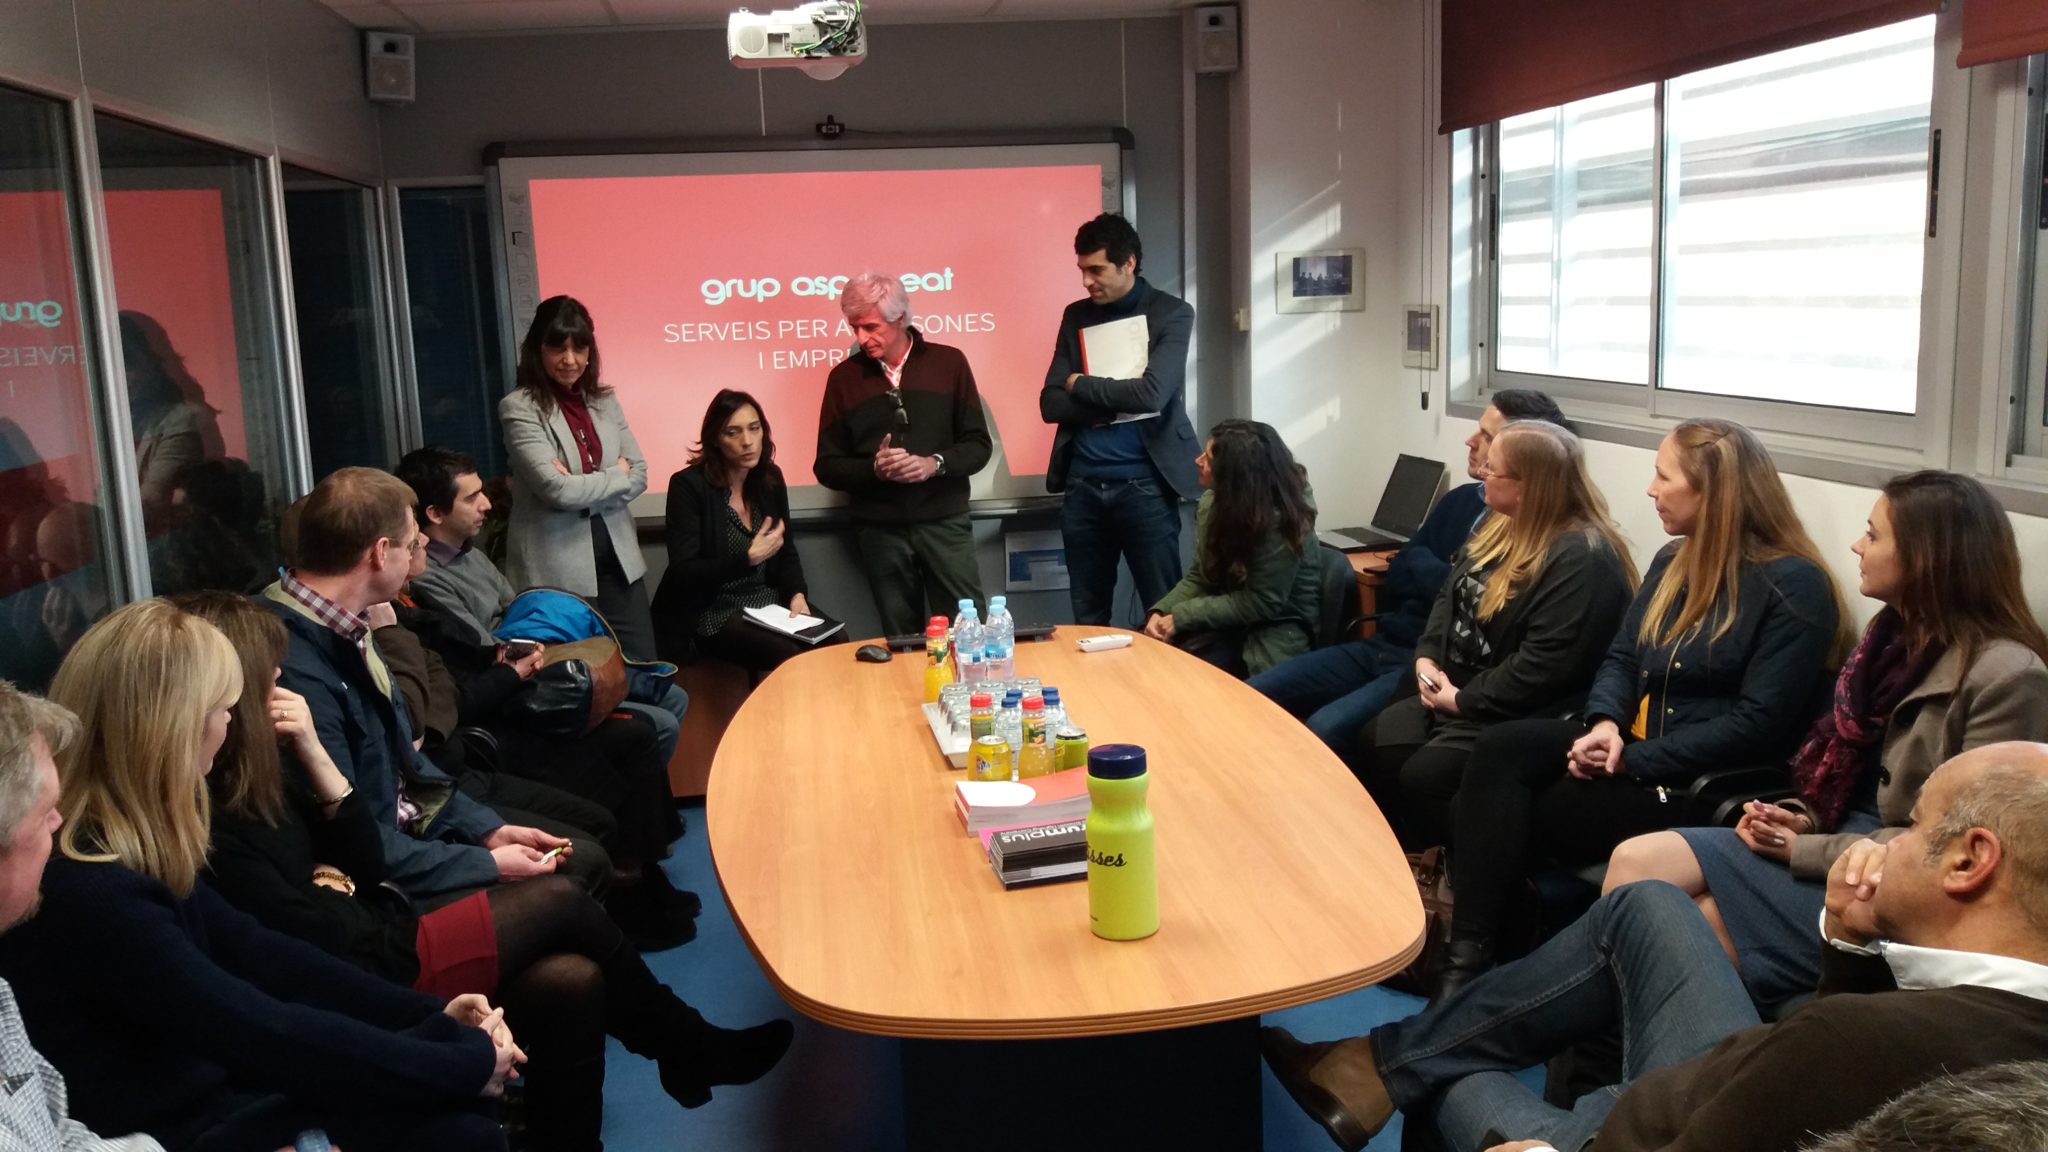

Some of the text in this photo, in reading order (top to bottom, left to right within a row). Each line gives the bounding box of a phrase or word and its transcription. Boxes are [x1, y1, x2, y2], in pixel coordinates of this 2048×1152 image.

[701, 267, 954, 305] grup aspeat
[664, 320, 771, 343] SERVEIS
[778, 318, 828, 340] PER
[911, 312, 996, 334] SONES
[758, 347, 850, 369] I EMPR
